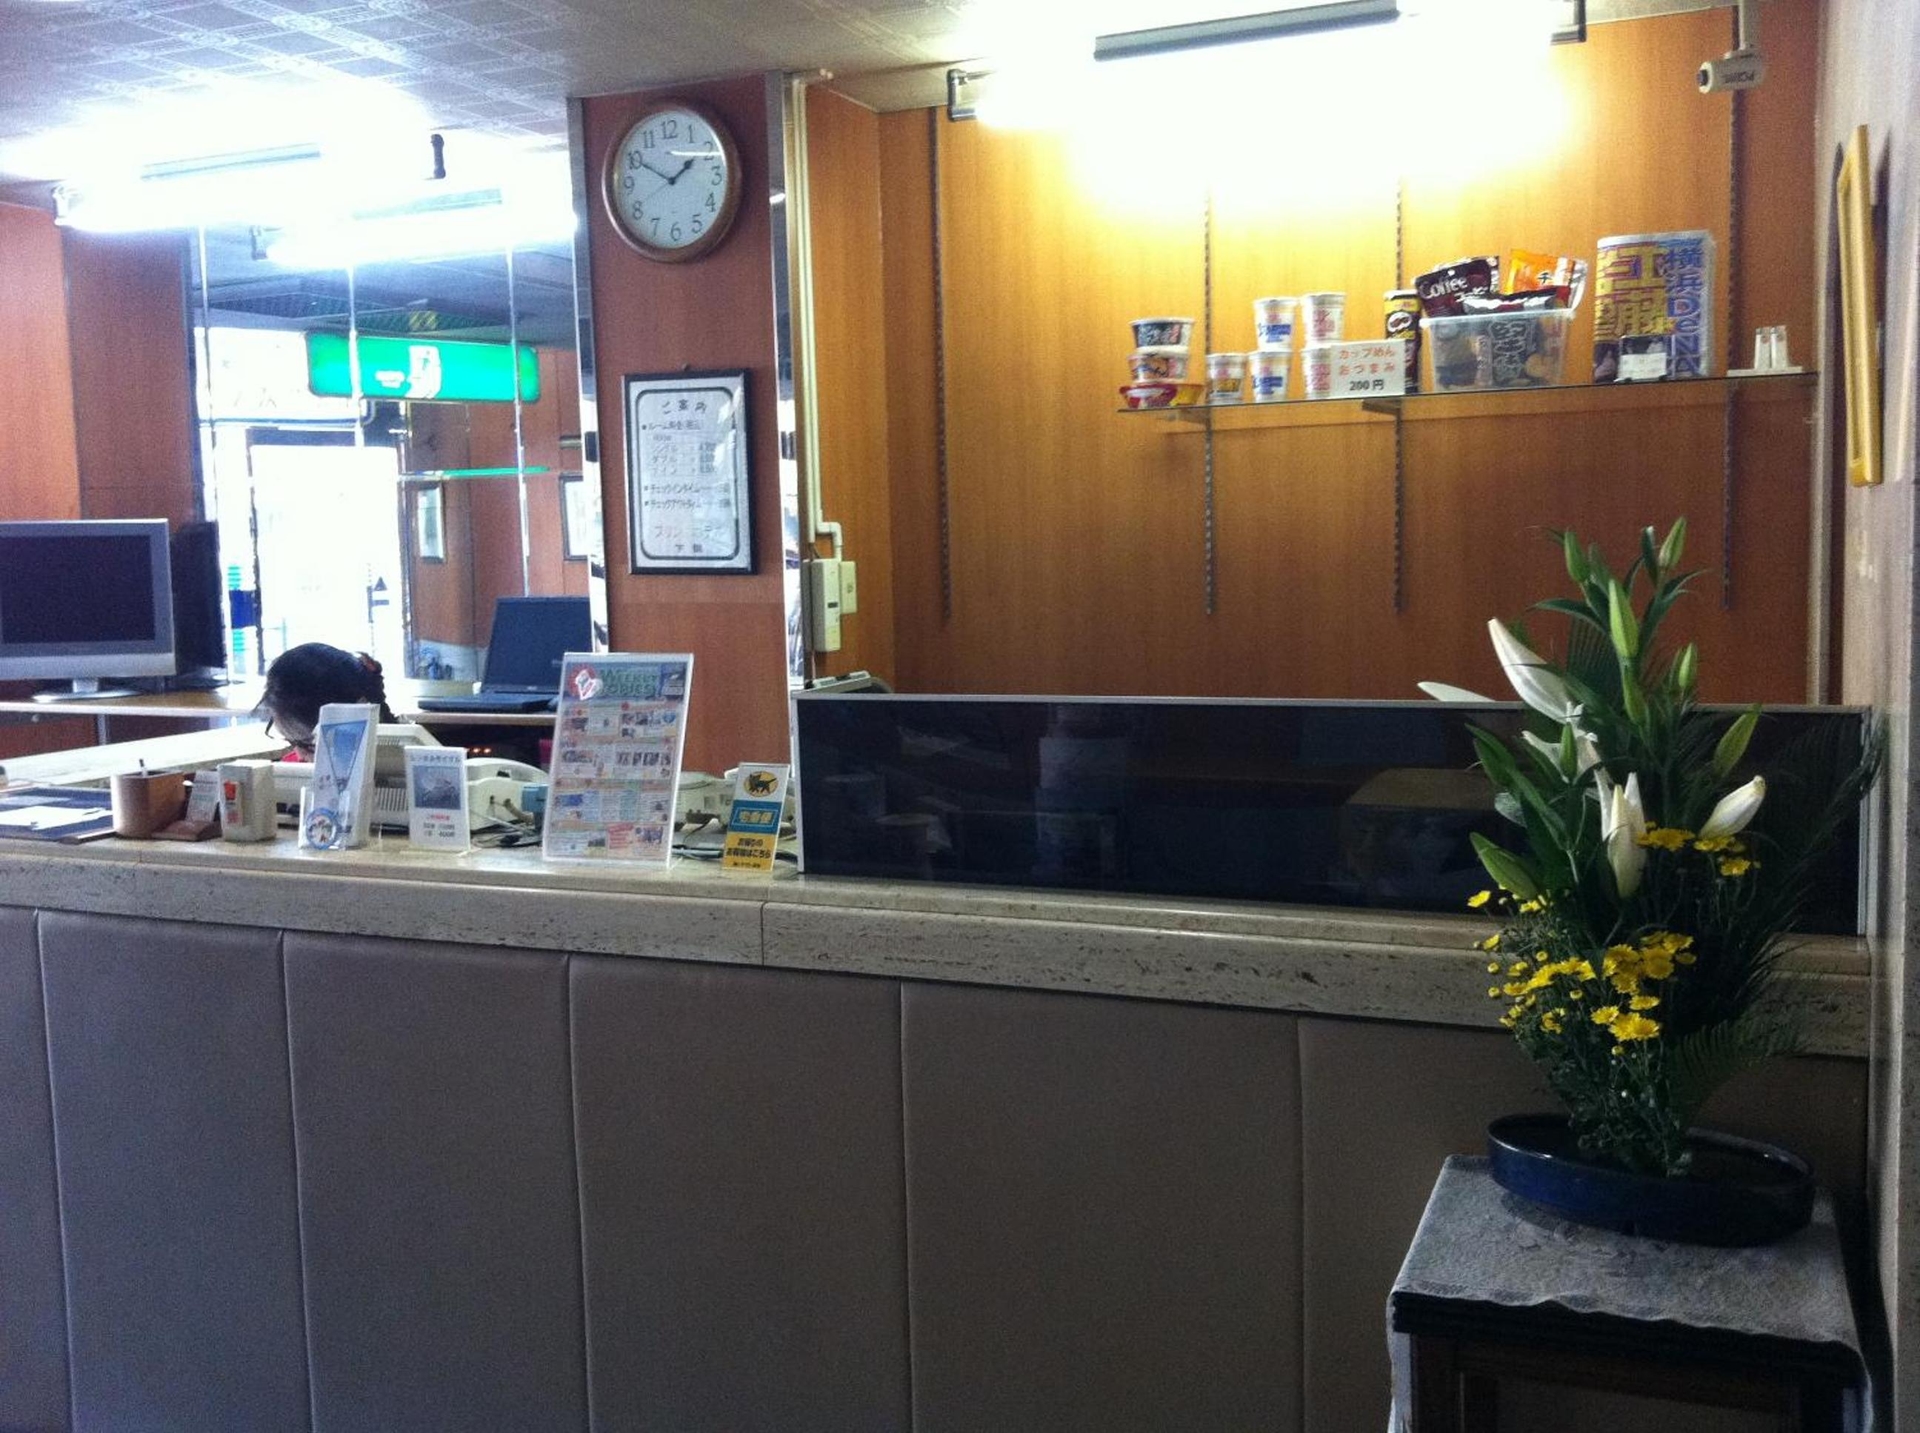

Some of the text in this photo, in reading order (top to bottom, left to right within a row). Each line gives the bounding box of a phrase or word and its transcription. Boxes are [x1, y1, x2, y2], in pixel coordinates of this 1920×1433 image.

[660, 120, 677, 139] 12
[687, 125, 694, 143] 1
[642, 131, 655, 148] 11
[704, 141, 714, 160] 2
[628, 151, 641, 169] 10
[711, 165, 721, 185] 3
[624, 176, 634, 194] 9
[632, 201, 643, 219] 8
[705, 193, 715, 212] 4
[651, 218, 660, 237] 7
[671, 222, 681, 241] 6
[692, 214, 702, 233] 5
[1339, 347, 1395, 359] カップめん
[1339, 363, 1395, 375] おつまみ
